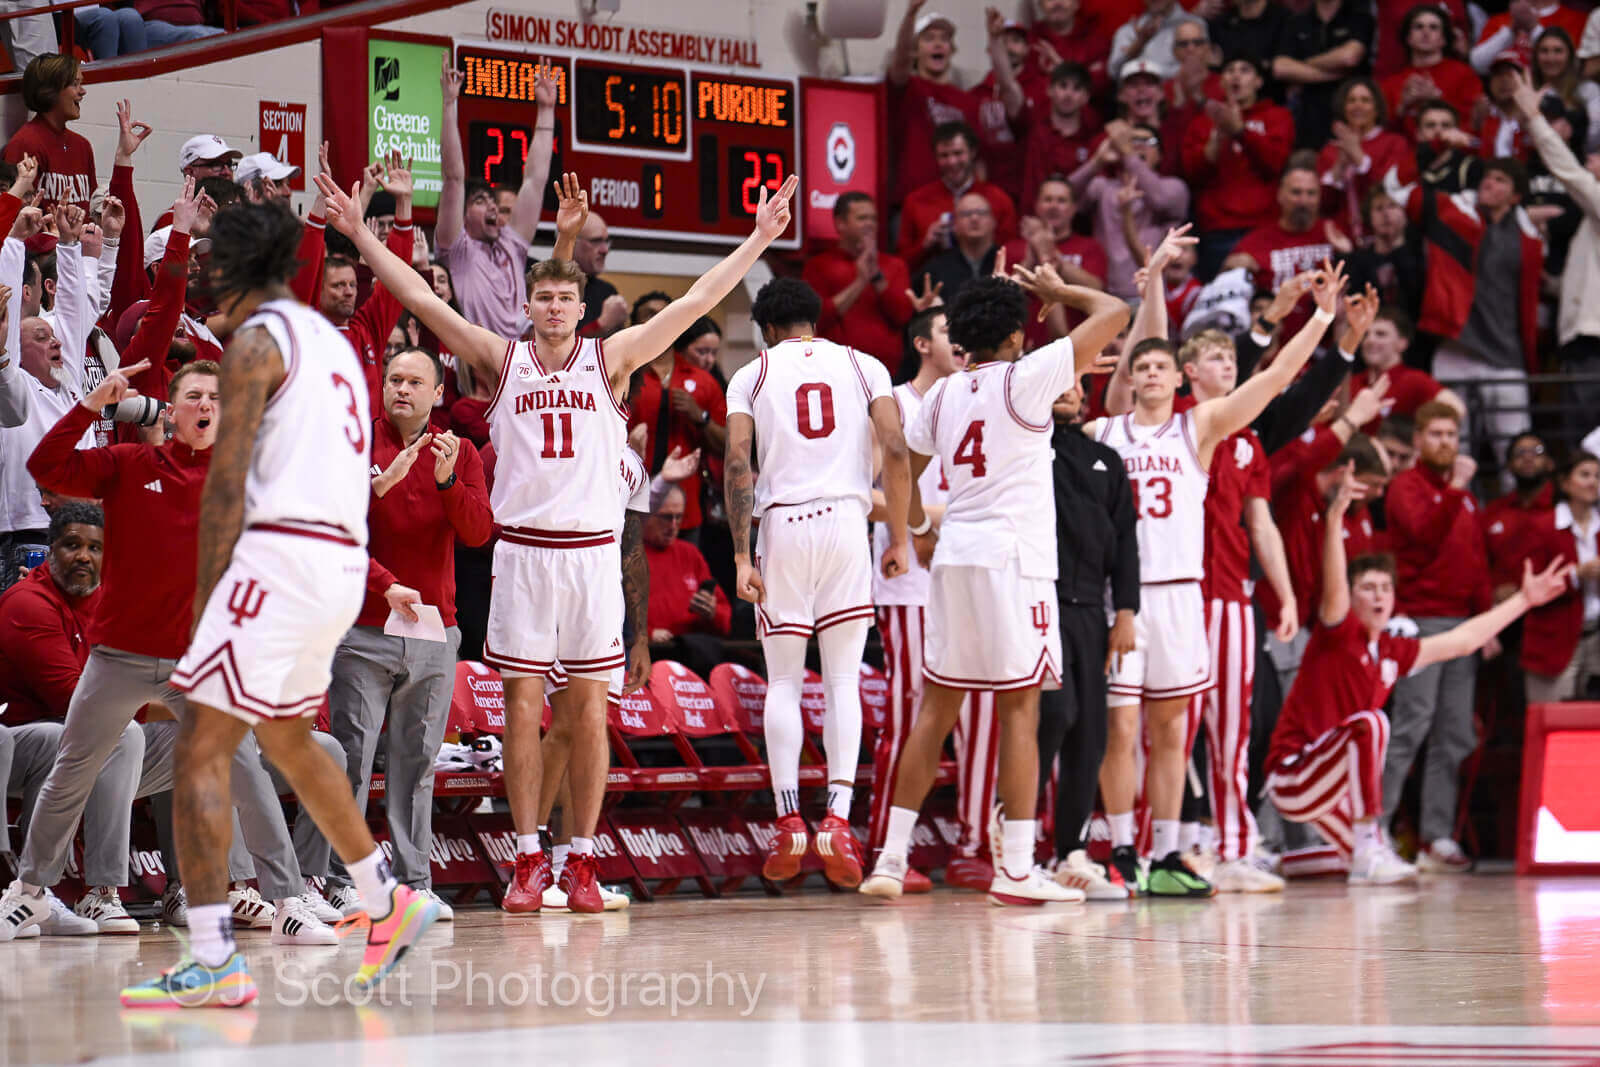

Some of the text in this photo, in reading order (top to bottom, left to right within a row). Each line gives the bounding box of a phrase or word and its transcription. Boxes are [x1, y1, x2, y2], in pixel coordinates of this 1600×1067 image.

[491, 12, 762, 69] SIMON SKJODT ASSEMBLY HALL
[464, 56, 566, 104] INDIAA
[263, 110, 303, 133] SECTION
[374, 105, 430, 134] Greene
[606, 75, 682, 144] 5:10
[698, 80, 787, 127] PURDUE
[277, 134, 289, 166] 4
[591, 178, 640, 208] PERIOD
[654, 173, 662, 211] 1
[331, 372, 365, 454] 3
[515, 389, 597, 415] INDIANA
[795, 382, 836, 440] 0
[540, 413, 575, 459] 11
[953, 420, 987, 478] 4
[1124, 455, 1184, 476] DIANA
[467, 675, 504, 692] Germa
[473, 692, 505, 709] Americ
